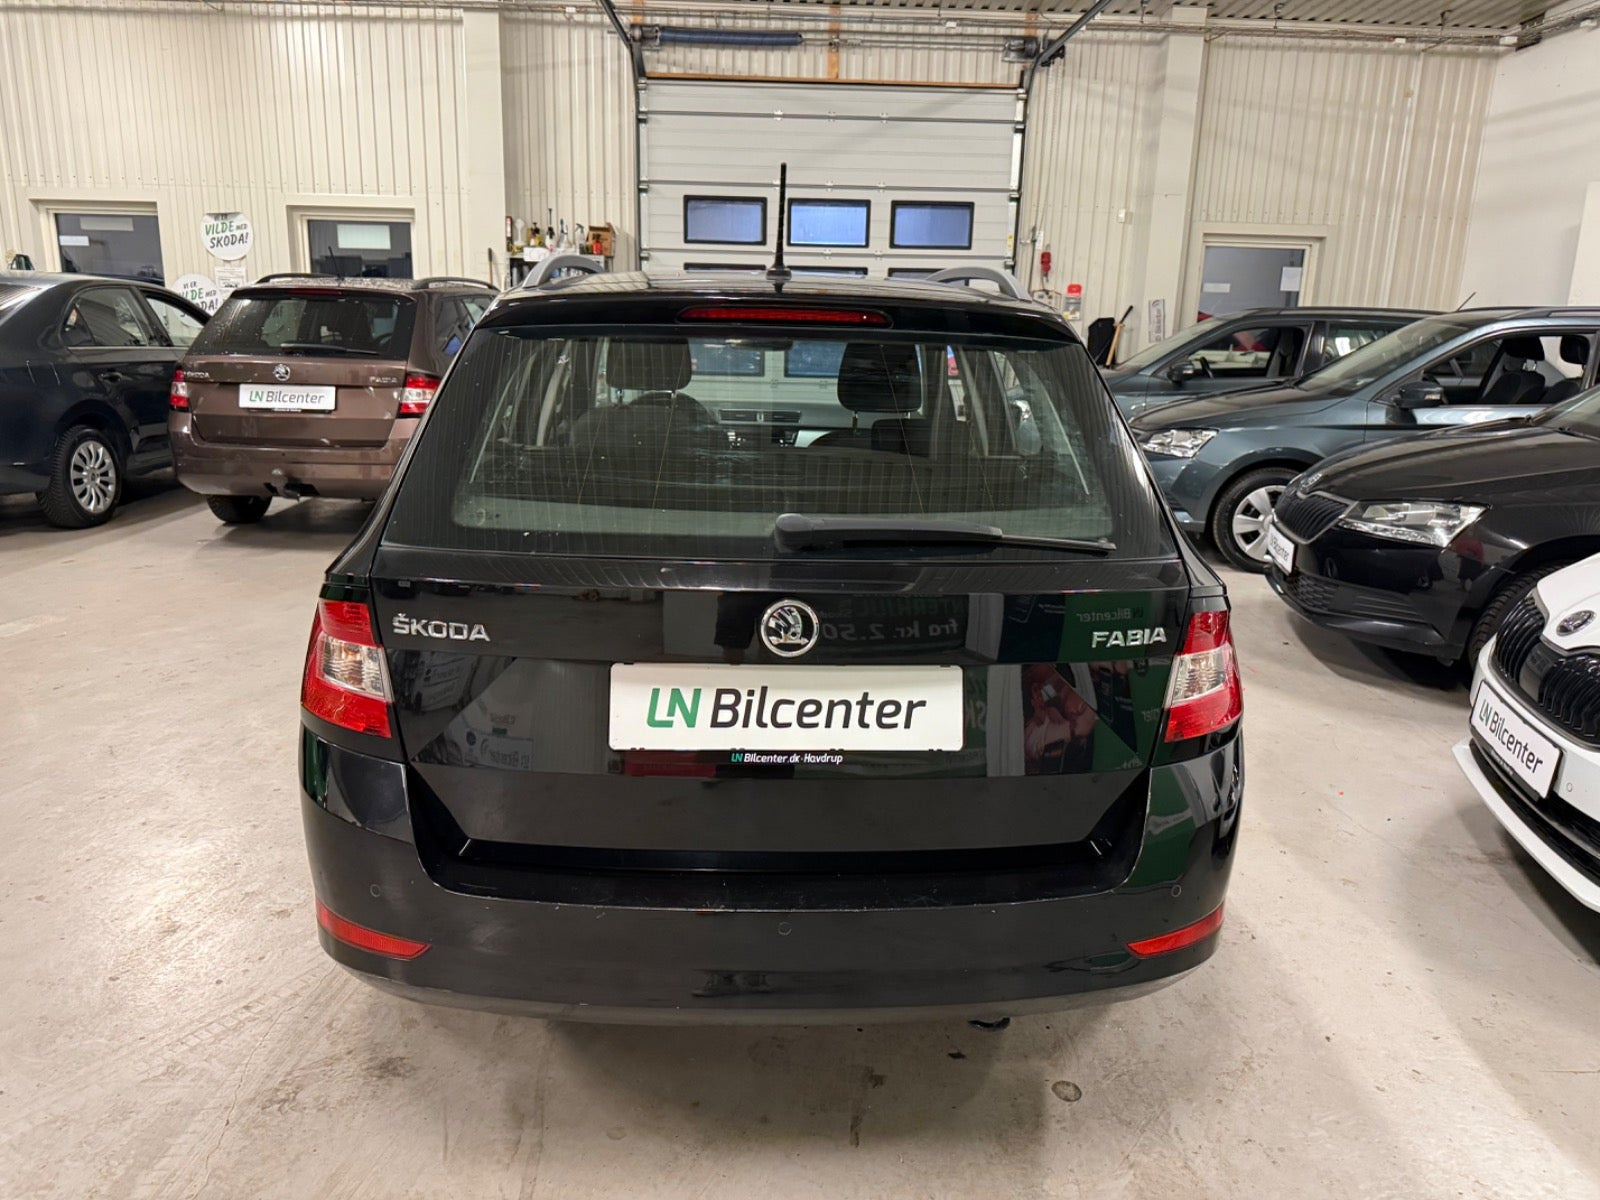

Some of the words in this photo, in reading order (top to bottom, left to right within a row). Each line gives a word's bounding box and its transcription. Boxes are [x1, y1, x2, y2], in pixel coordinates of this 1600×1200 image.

[204, 221, 234, 236] VILDE
[210, 232, 249, 248] SKODA!
[249, 390, 264, 402] LN
[265, 390, 325, 404] Bilcenter
[391, 612, 491, 642] ŠKODA
[1091, 626, 1167, 649] FABIA
[646, 687, 702, 728] LN
[709, 685, 927, 730] Bilcenter
[1479, 698, 1493, 727] LN
[1488, 710, 1544, 774] Bilcenter
[731, 753, 743, 763] LN
[804, 753, 844, 765] Havdrup
